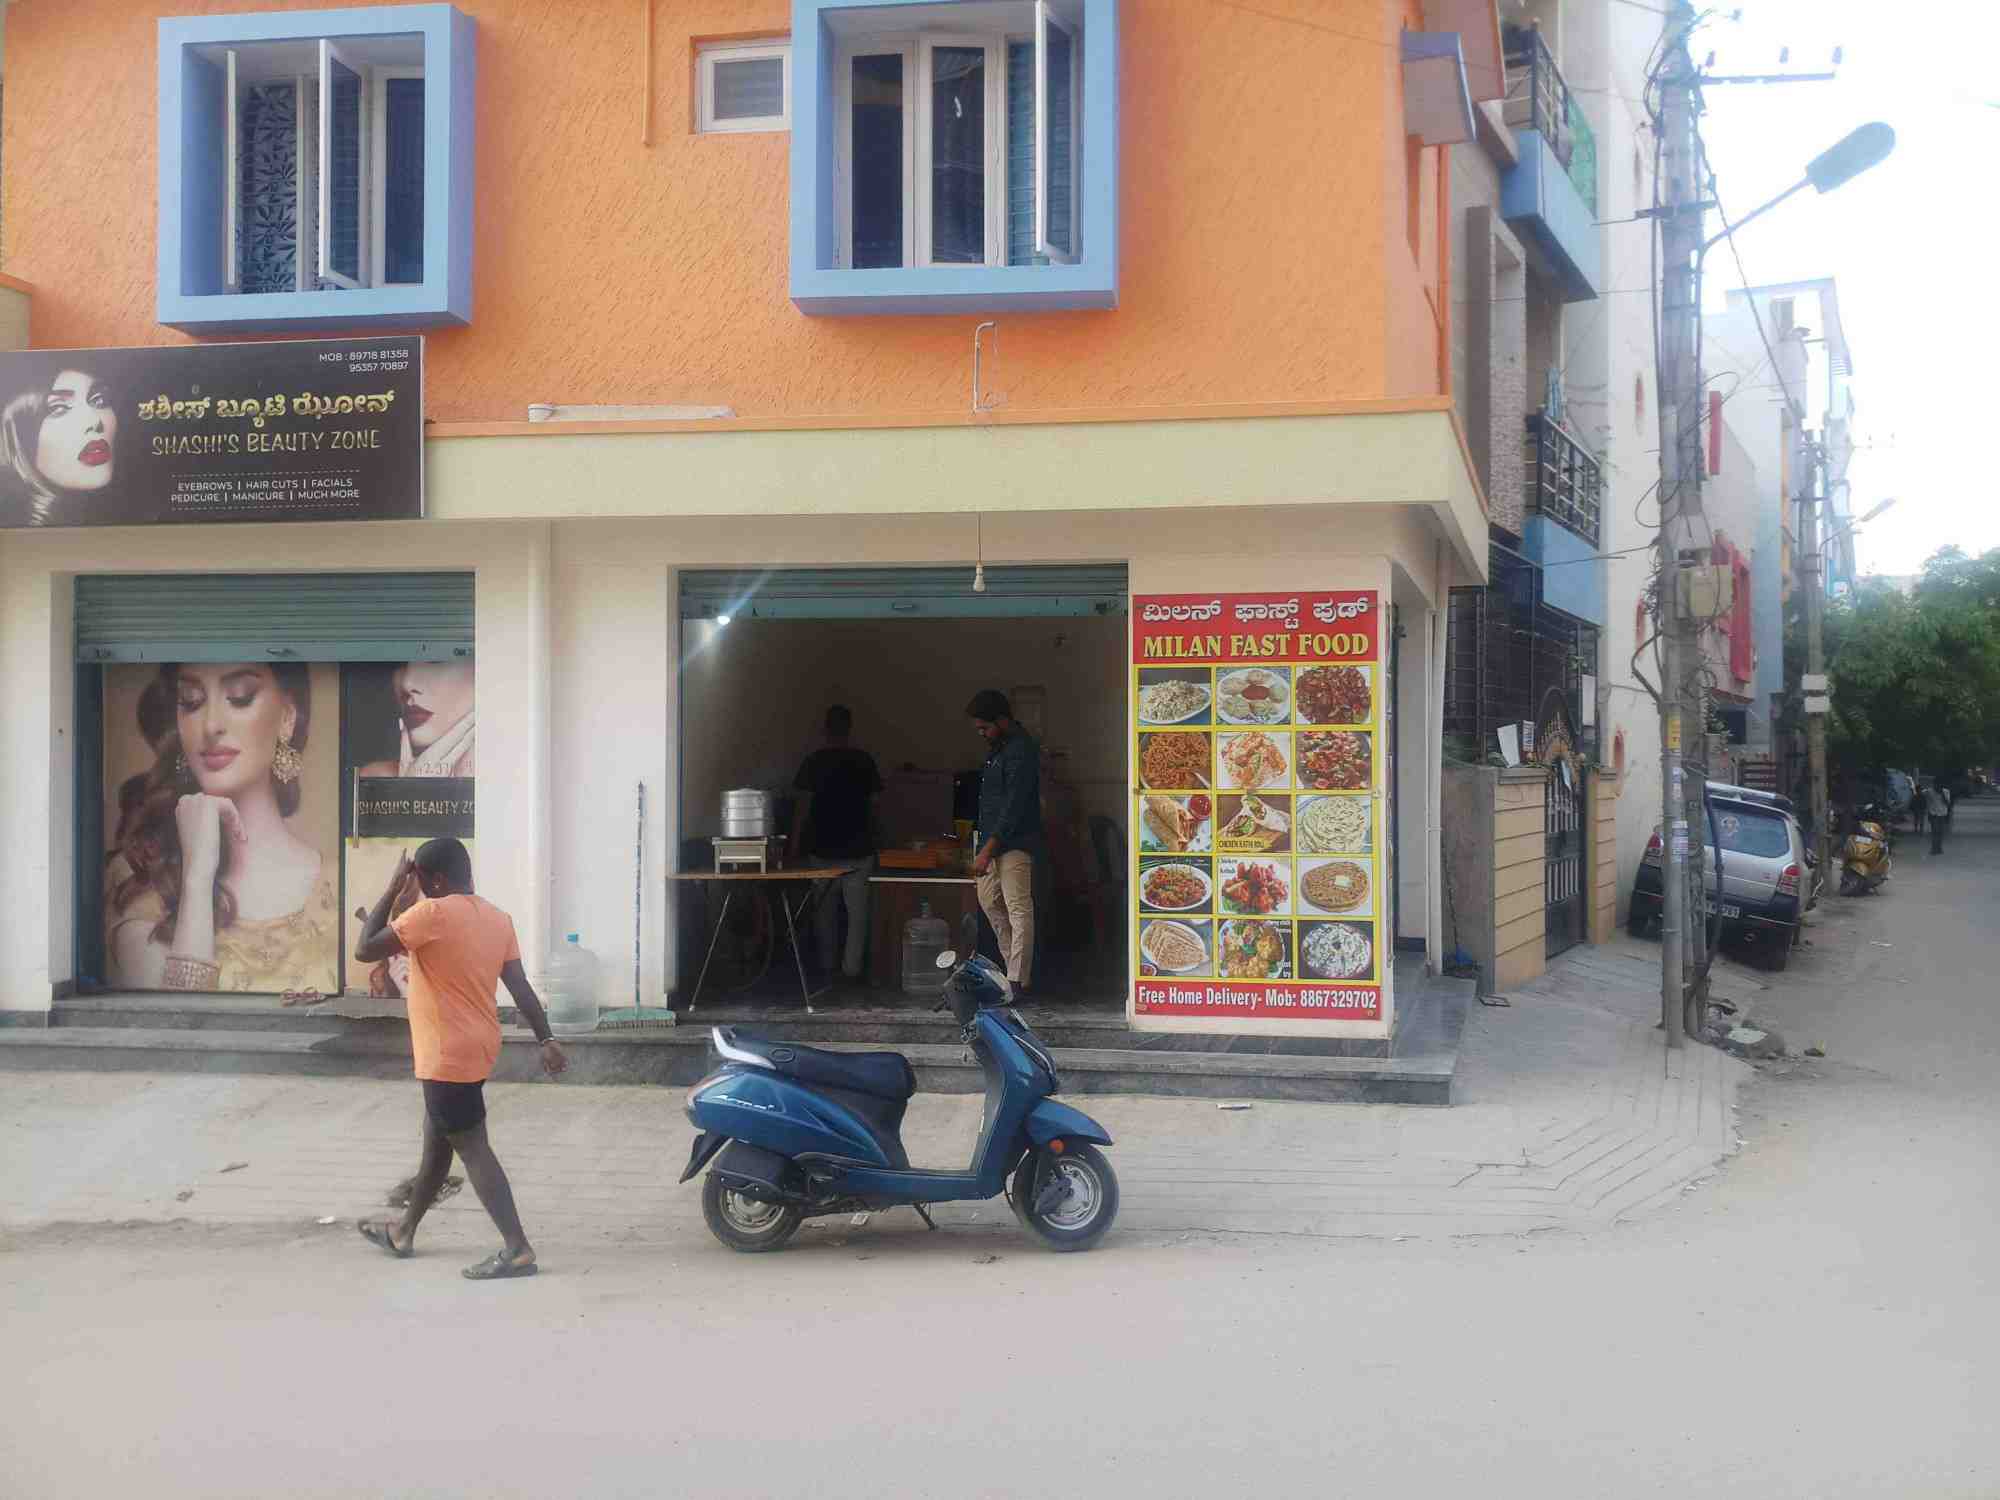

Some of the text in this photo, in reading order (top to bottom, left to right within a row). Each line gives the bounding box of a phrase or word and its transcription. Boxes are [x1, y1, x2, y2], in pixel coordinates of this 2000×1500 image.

[319, 352, 343, 362] MOB
[151, 429, 382, 456] SHASHI'S BEAUTY ZONE
[177, 481, 233, 492] EYEBROWS
[245, 480, 269, 490] HAIR
[271, 479, 298, 489] CUTS
[311, 478, 353, 488] FACIALS
[171, 493, 220, 503] PEDICURE
[232, 491, 285, 502] MANICURE
[298, 490, 328, 500] MUCH
[330, 489, 361, 499] MORE
[1142, 600, 1221, 622] ಮಿಲನ್
[1143, 633, 1370, 658] MILAN FAST FOOD
[413, 800, 459, 815] BEAUTY
[1138, 986, 1166, 1004] Free
[1169, 986, 1203, 1005] Home
[1265, 989, 1297, 1007] Mob:
[1300, 989, 1377, 1009] 8867329702
